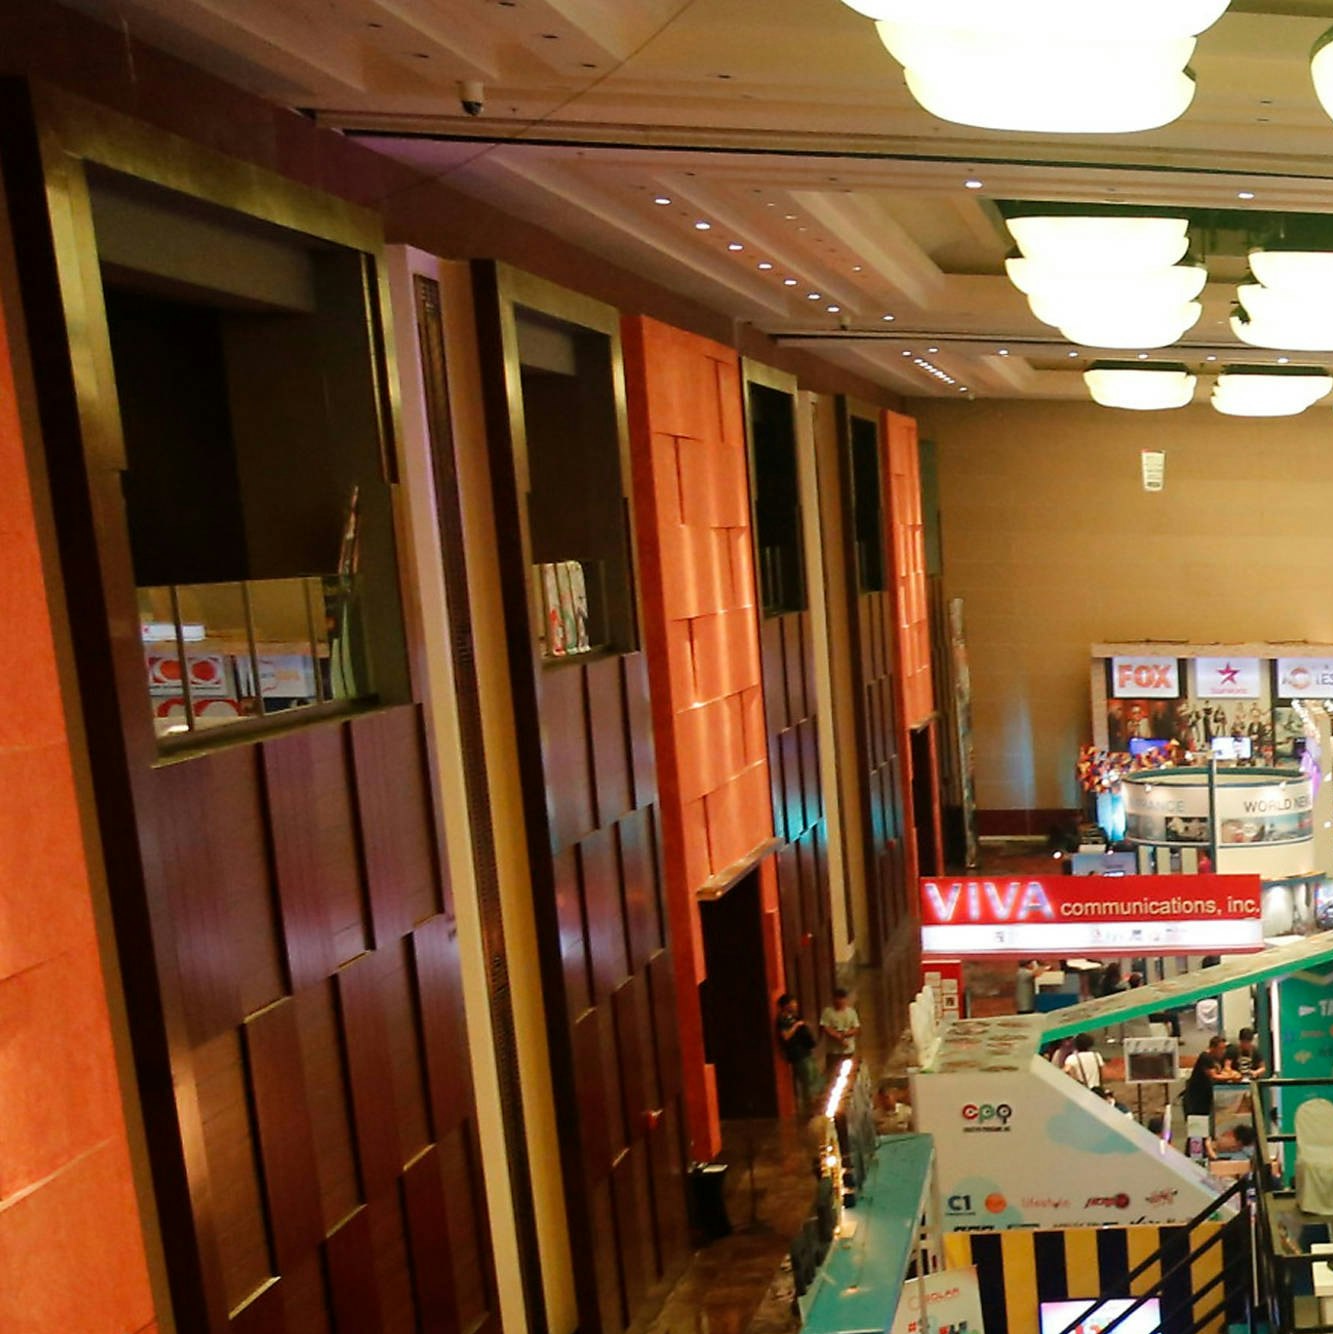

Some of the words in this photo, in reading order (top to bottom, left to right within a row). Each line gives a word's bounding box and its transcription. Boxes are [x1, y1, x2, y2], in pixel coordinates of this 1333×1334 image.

[1118, 664, 1171, 689] FOX
[1244, 799, 1294, 814] WORLD
[925, 881, 1053, 921] VIVA
[1061, 895, 1222, 917] communications,
[1227, 894, 1260, 914] inc.
